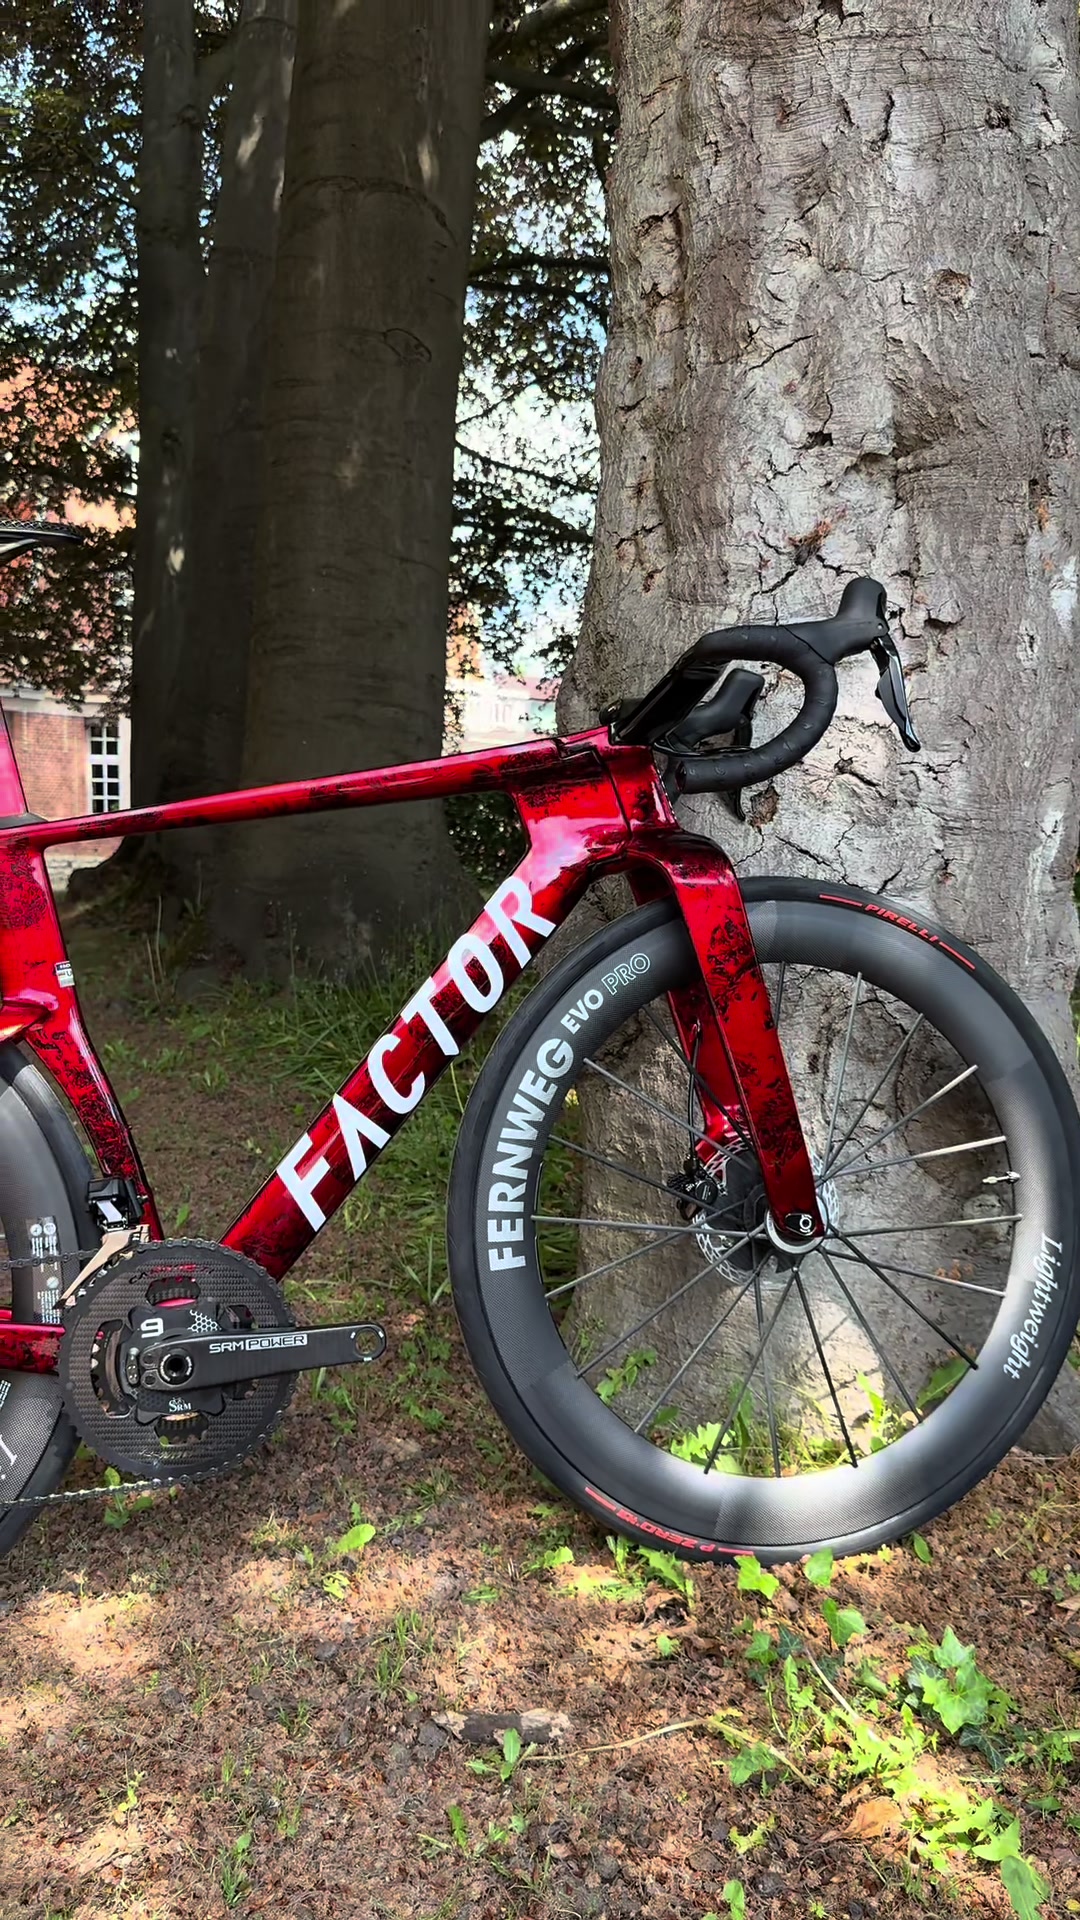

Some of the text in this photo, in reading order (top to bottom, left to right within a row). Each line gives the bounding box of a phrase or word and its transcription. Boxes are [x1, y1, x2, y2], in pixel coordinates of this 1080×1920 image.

[865, 903, 939, 943] PIRELLI
[276, 875, 556, 1232] FACTOR
[487, 952, 651, 1272] FERNWEG EVO PRO
[1003, 1232, 1063, 1380] Lightweight
[140, 1317, 164, 1339] 9
[209, 1333, 308, 1354] SRM POWER
[168, 1399, 192, 1413] SRM
[640, 1521, 716, 1553] P ZERO
